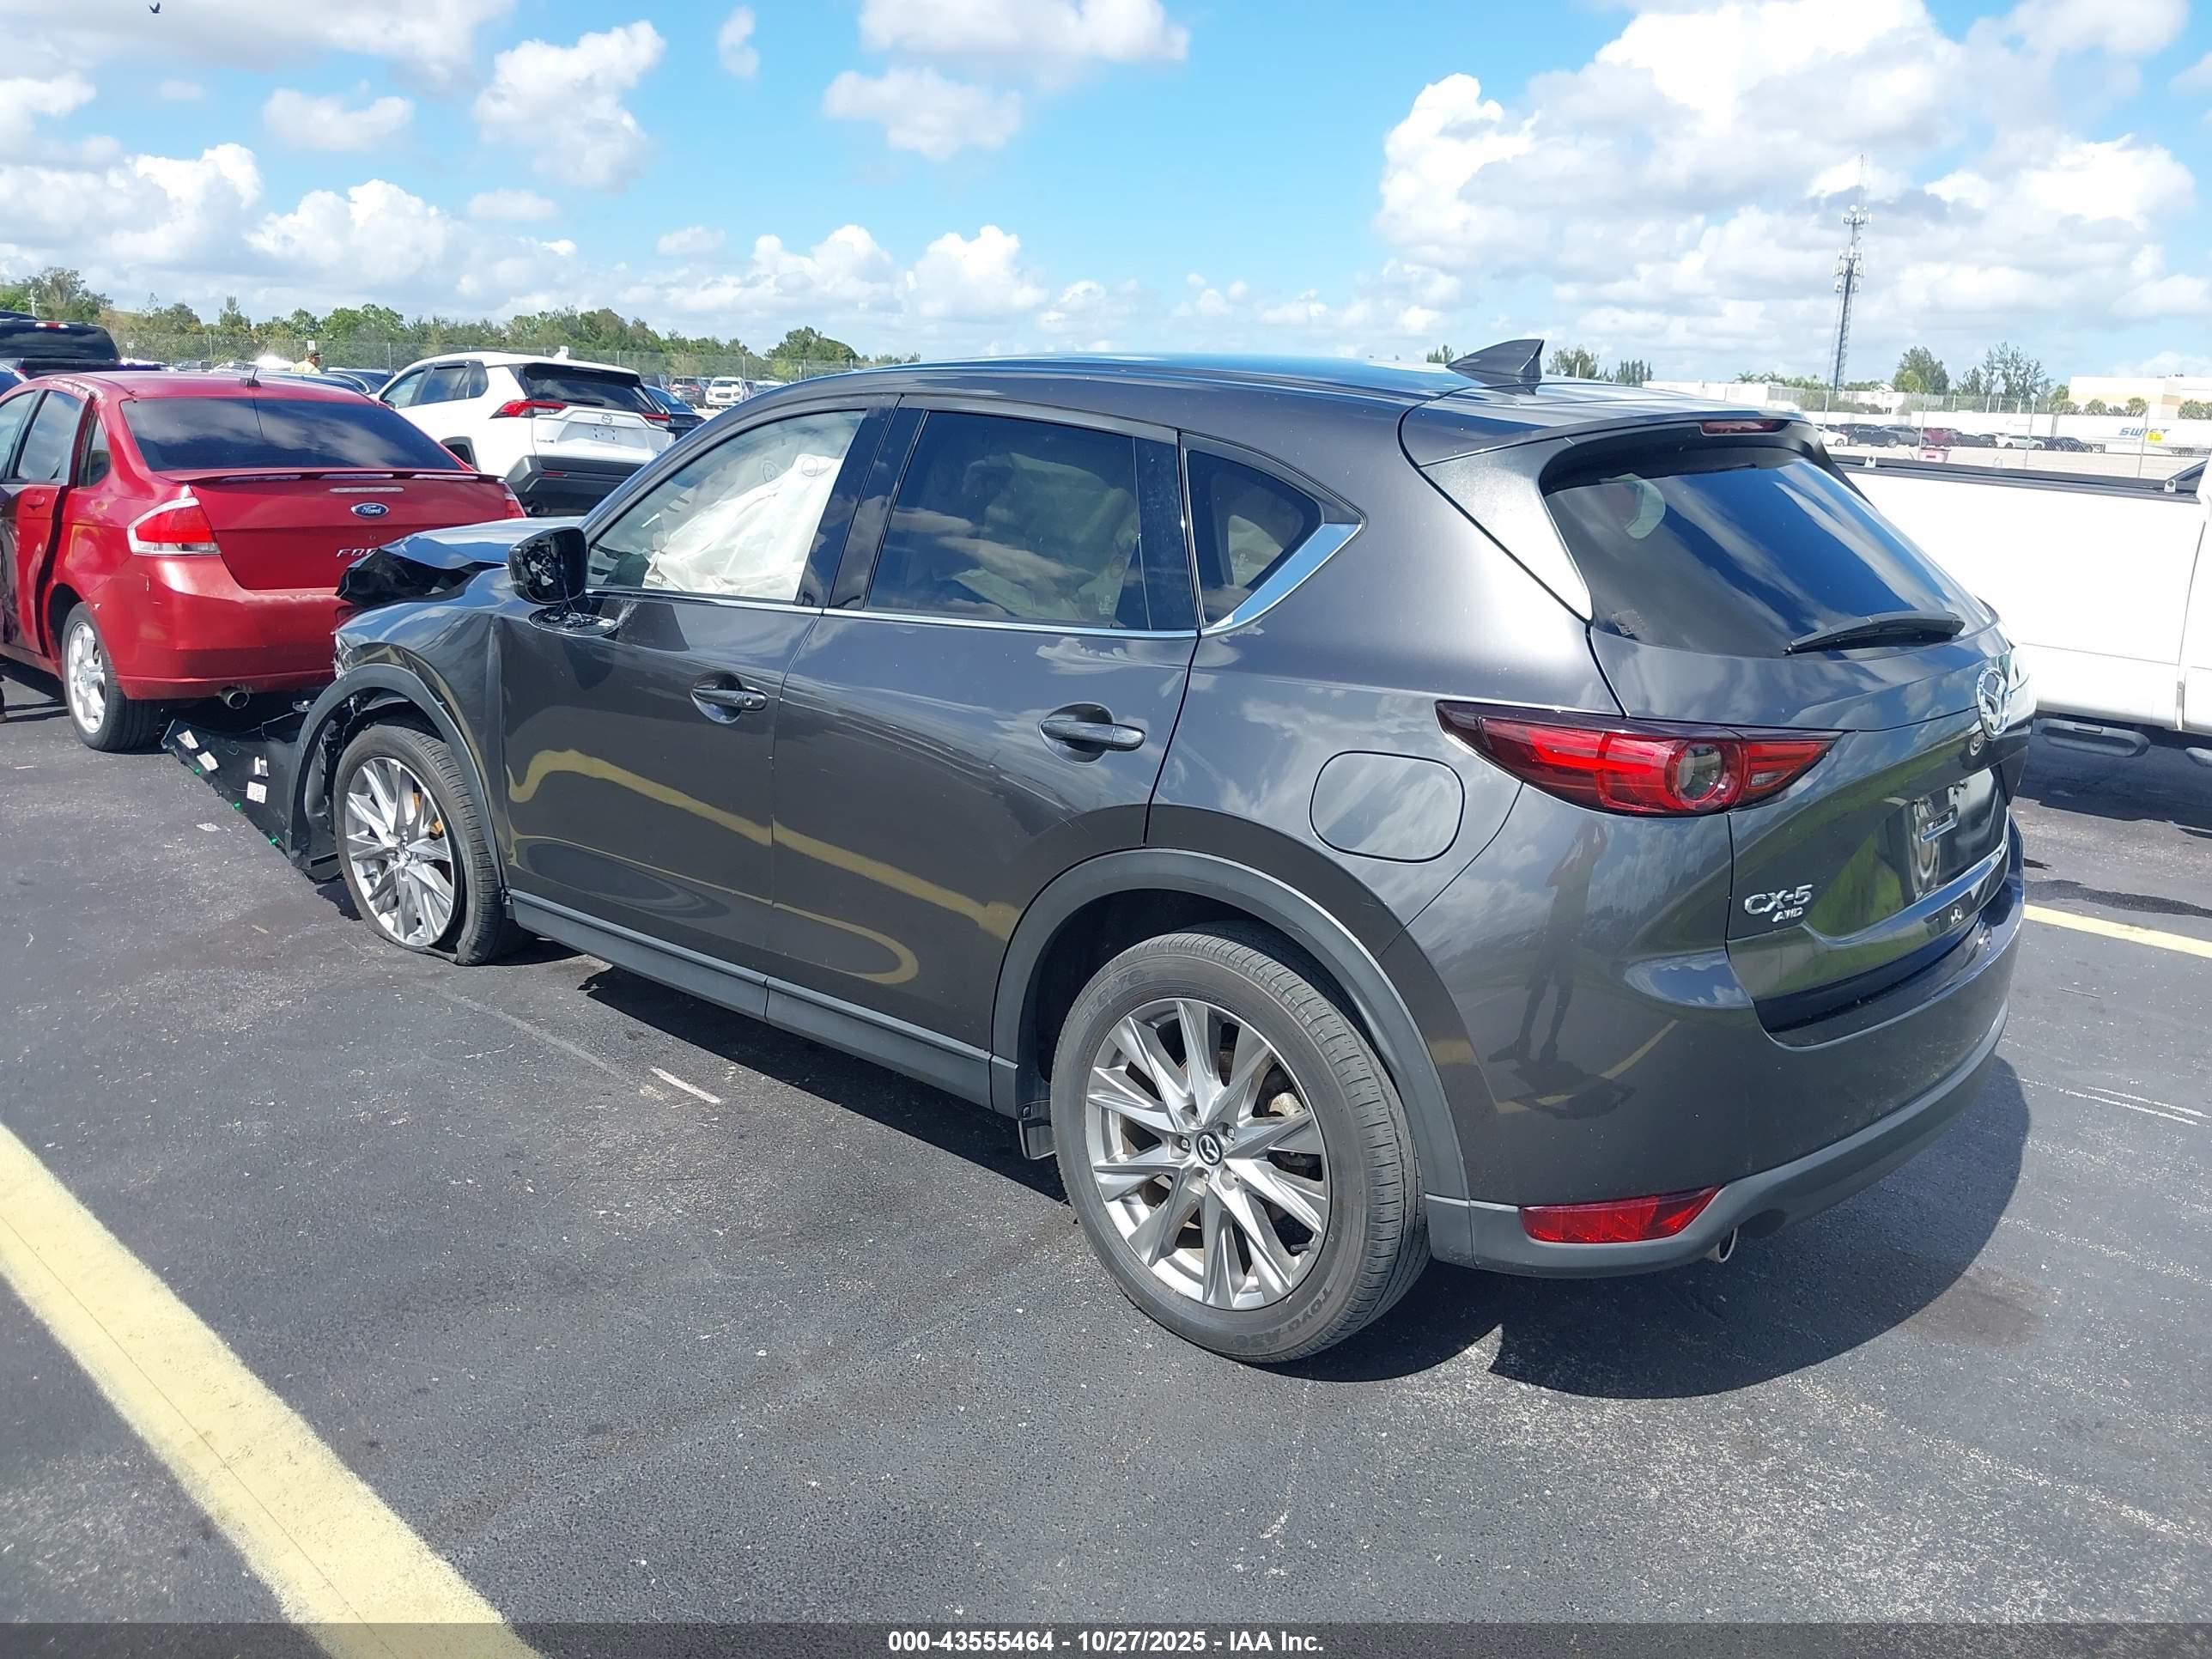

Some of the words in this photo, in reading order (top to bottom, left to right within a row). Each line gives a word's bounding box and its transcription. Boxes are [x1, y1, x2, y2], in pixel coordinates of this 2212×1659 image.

[362, 505, 382, 514] Ford
[1744, 884, 1814, 915] CX-5
[1771, 907, 1803, 923] AWD
[1287, 1287, 1333, 1333] TOYO
